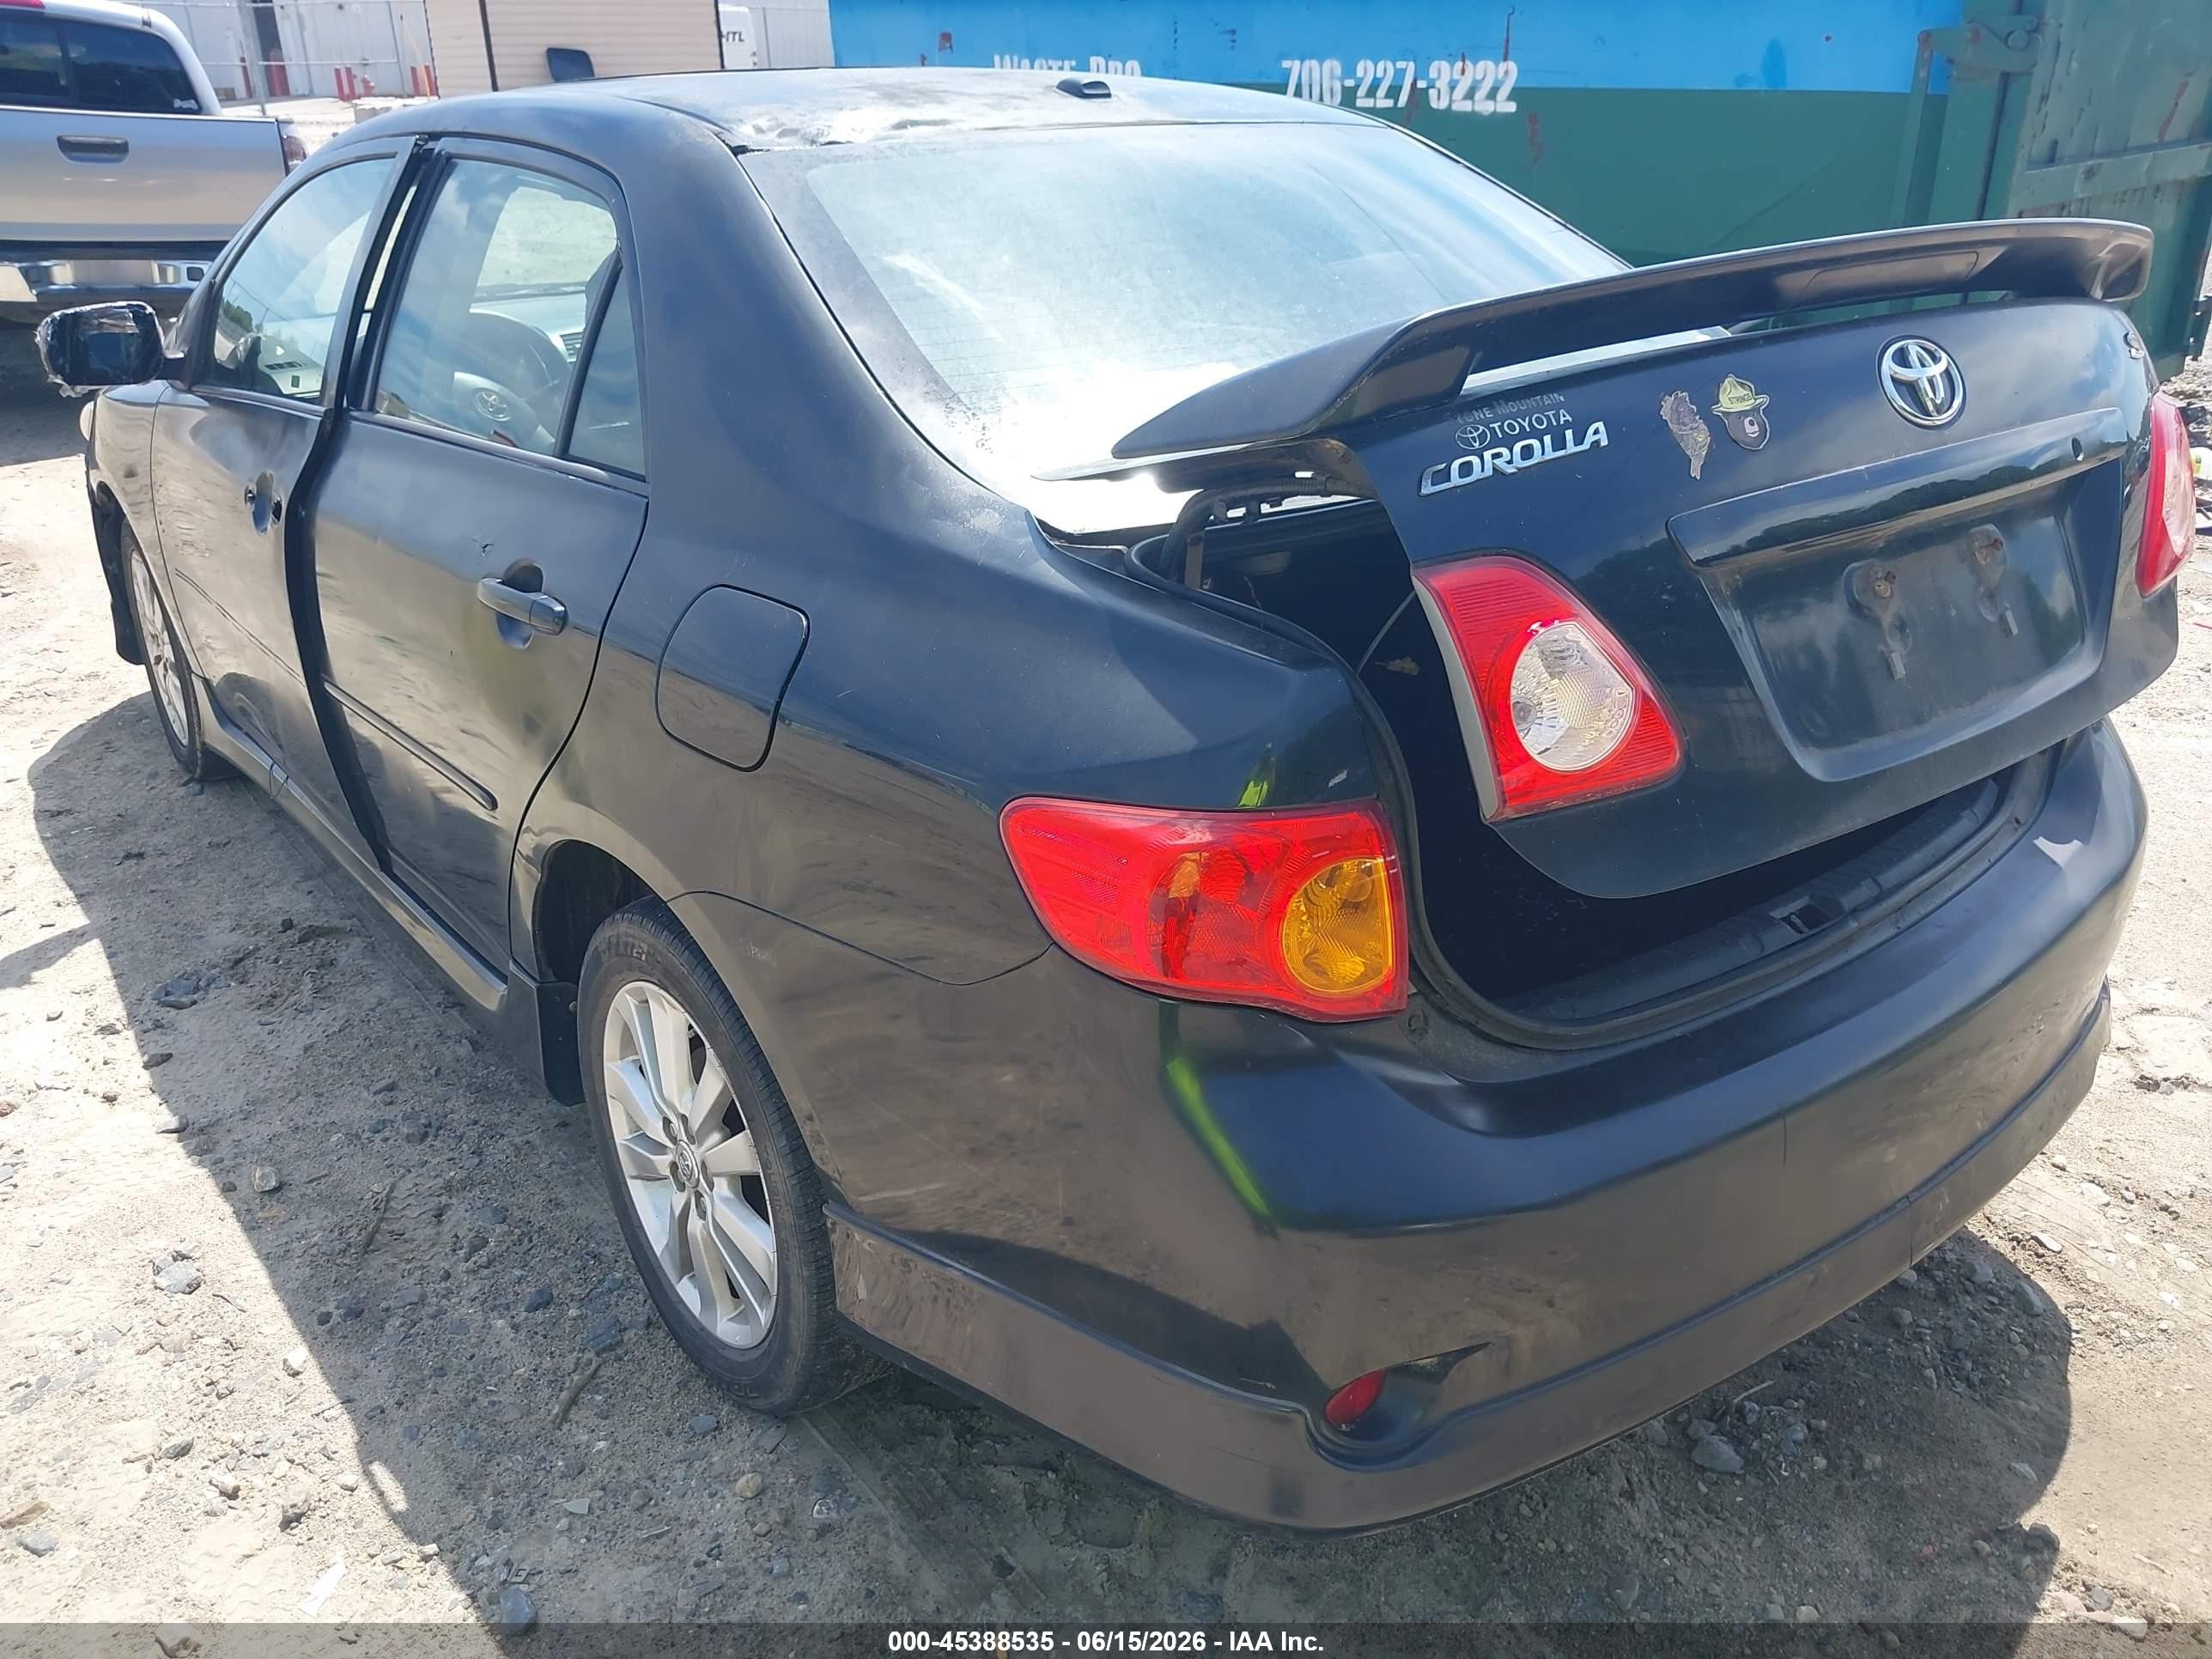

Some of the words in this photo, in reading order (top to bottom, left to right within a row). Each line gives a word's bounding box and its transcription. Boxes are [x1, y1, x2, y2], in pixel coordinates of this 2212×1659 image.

[1281, 59, 1518, 113] 706-227-3222
[1489, 409, 1573, 438] TOYOTA
[1419, 421, 1609, 495] COROLLA
